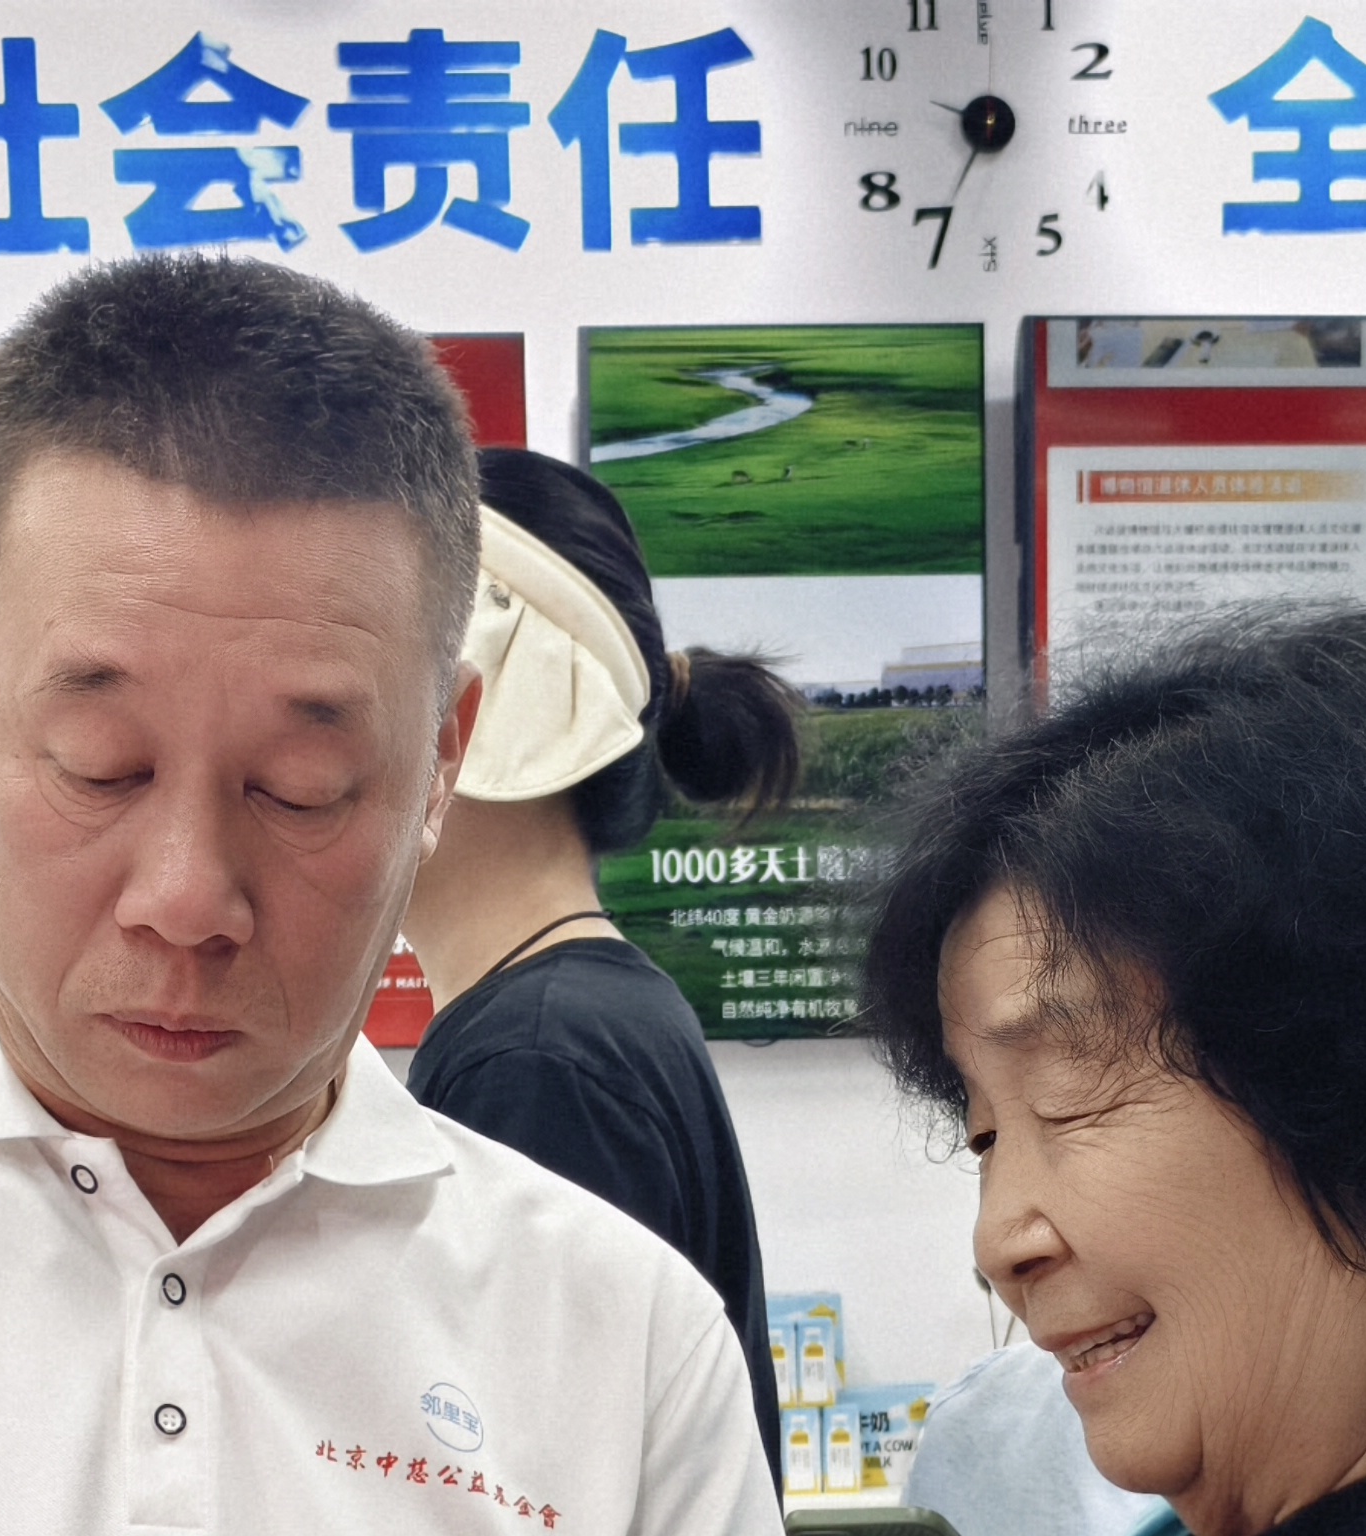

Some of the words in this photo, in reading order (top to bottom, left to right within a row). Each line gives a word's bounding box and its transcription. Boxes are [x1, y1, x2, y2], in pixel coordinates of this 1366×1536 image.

[907, 0, 940, 32] 11
[860, 46, 897, 82] 10
[1070, 41, 1114, 81] 2
[844, 118, 899, 137] nine
[1068, 114, 1128, 135] three
[857, 170, 902, 212] 8
[1085, 169, 1110, 212] 4
[912, 205, 954, 271] 7
[1036, 213, 1063, 257] 5
[669, 907, 740, 928] 北纬40度
[420, 1392, 480, 1437] 邻里宝
[884, 1440, 914, 1452] COW
